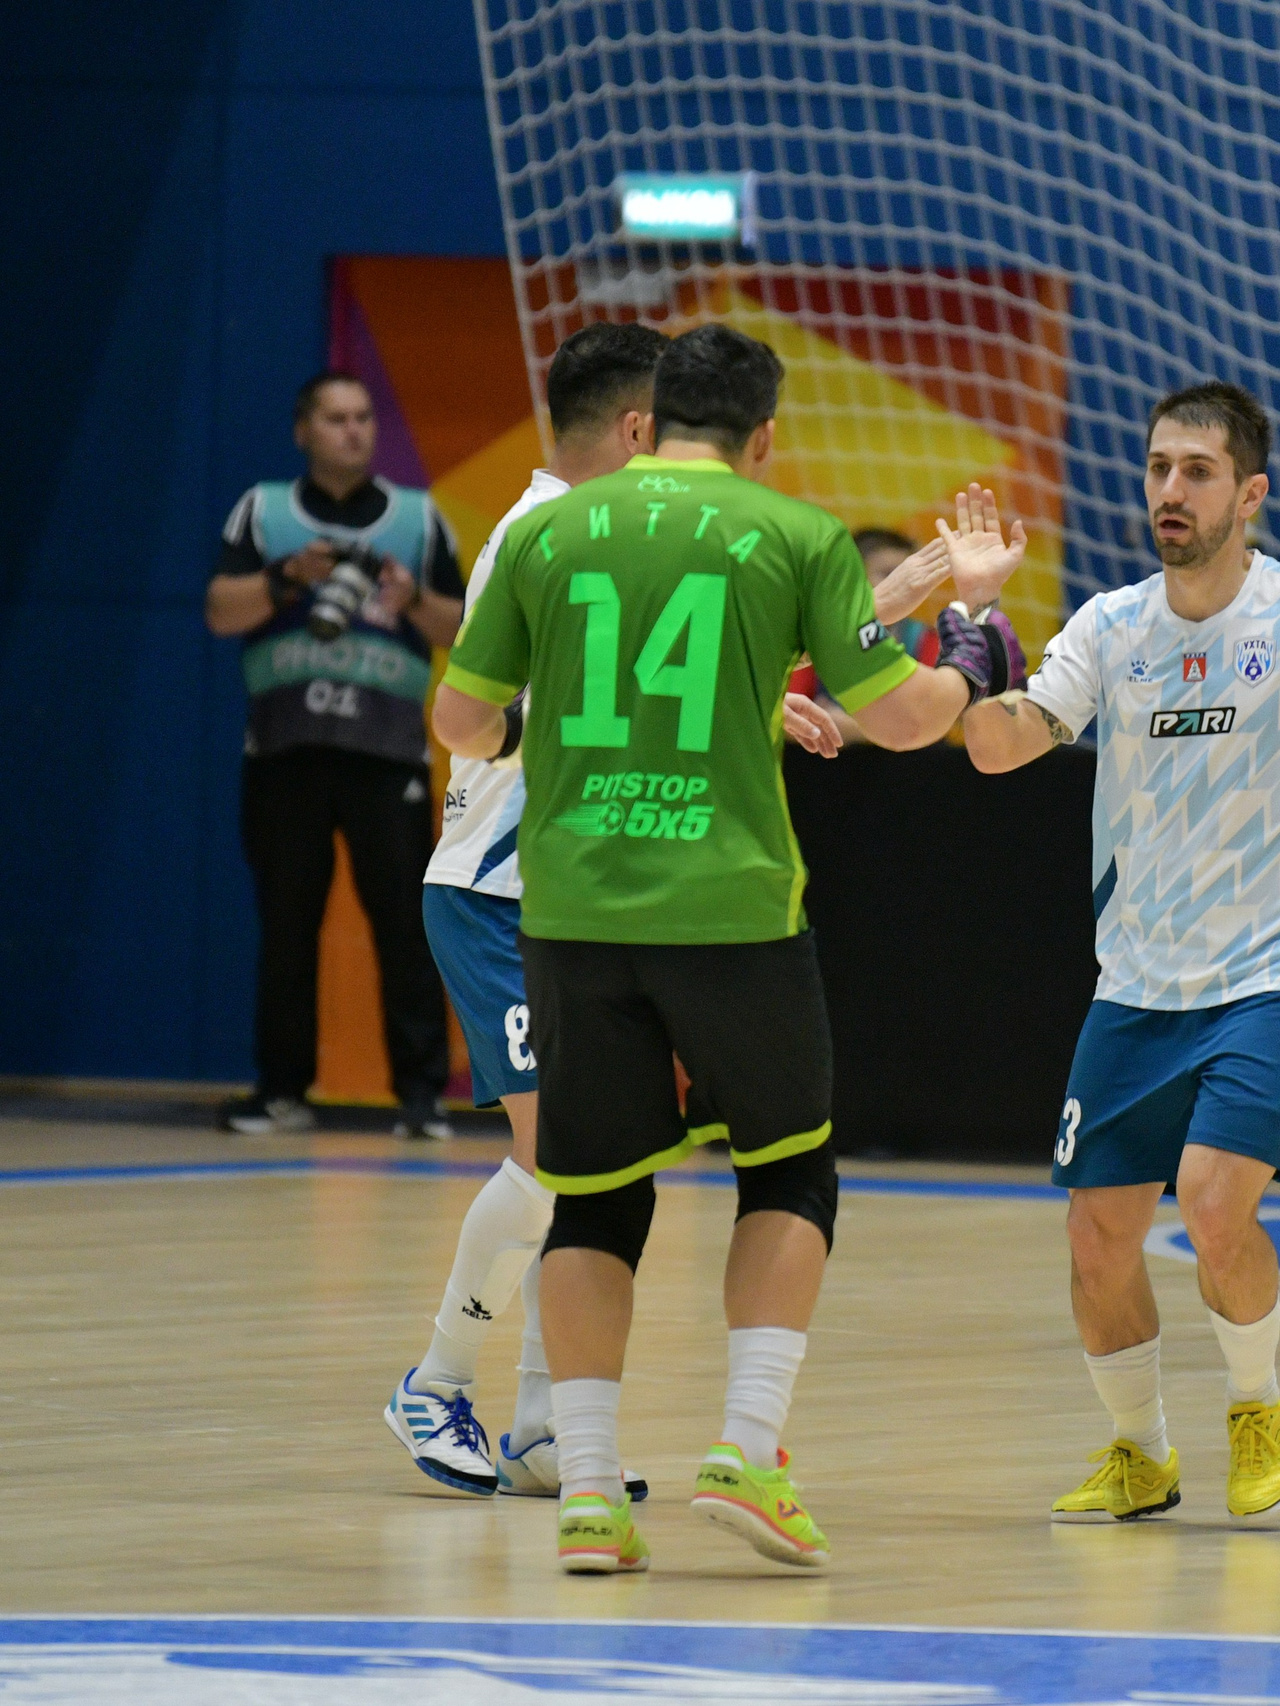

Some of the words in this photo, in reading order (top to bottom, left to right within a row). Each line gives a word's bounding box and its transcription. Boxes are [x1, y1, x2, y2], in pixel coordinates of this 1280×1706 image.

[538, 501, 763, 564] ГИТТА
[272, 637, 407, 682] PHOTO
[560, 572, 727, 753] 14
[1244, 640, 1267, 651] УХТА
[306, 680, 359, 718] 01
[1151, 708, 1234, 737] PARI
[581, 772, 709, 801] PITSTOP
[504, 1004, 537, 1071] 8
[1054, 1096, 1081, 1167] 3
